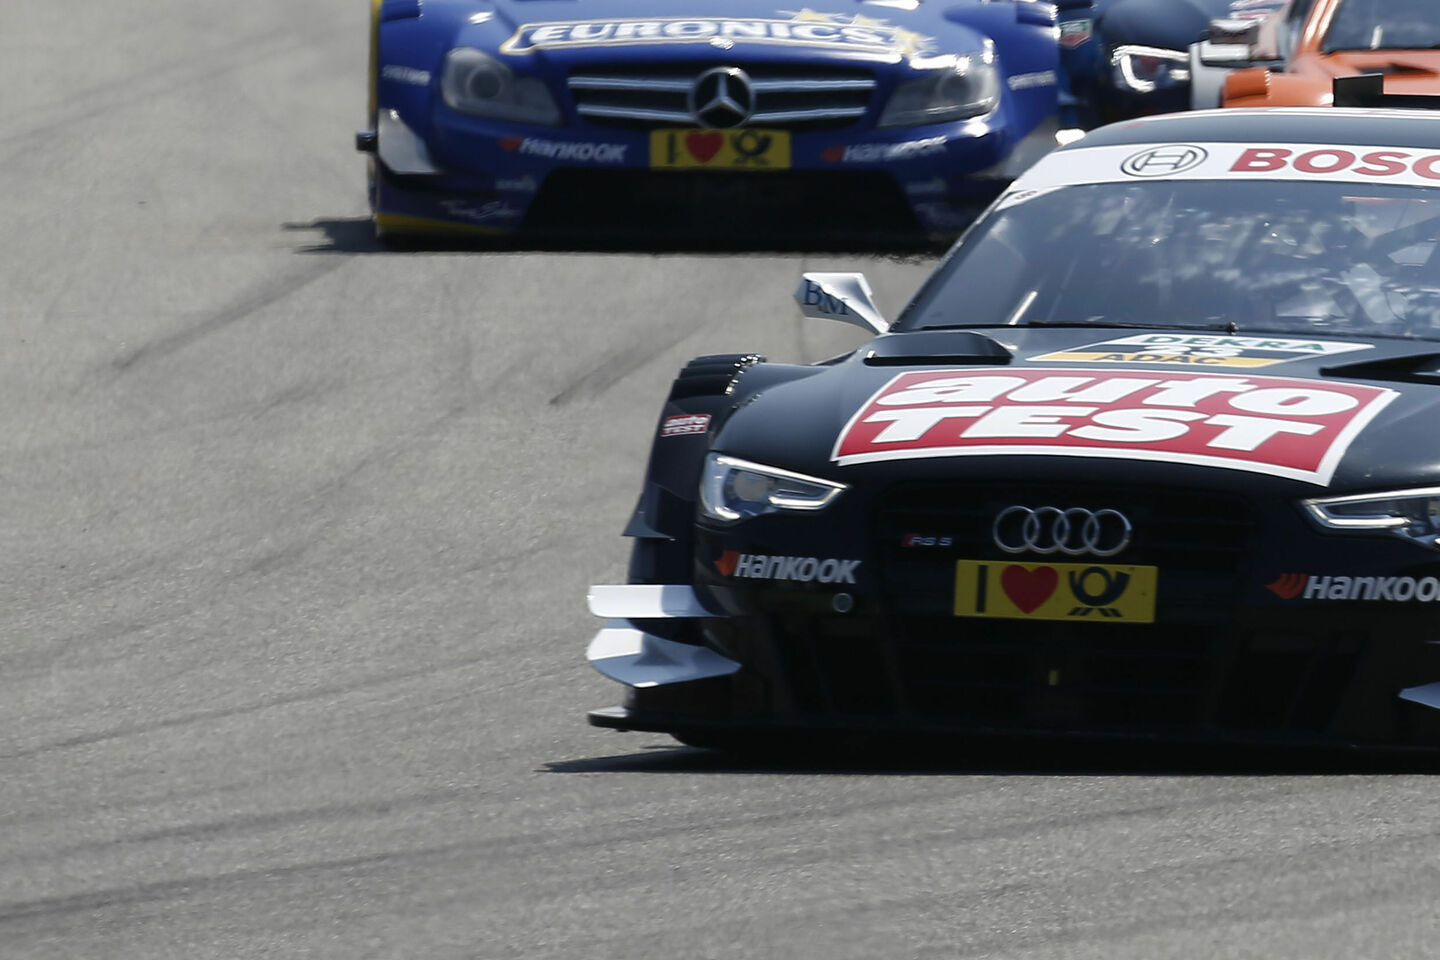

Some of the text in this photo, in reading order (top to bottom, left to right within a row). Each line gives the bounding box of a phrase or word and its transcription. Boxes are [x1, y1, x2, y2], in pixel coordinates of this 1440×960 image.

[529, 20, 888, 44] EURONICS
[1142, 335, 1327, 352] DEKRA
[1093, 352, 1227, 364] ADAC
[874, 375, 1360, 417] auto
[863, 405, 1328, 452] TEST
